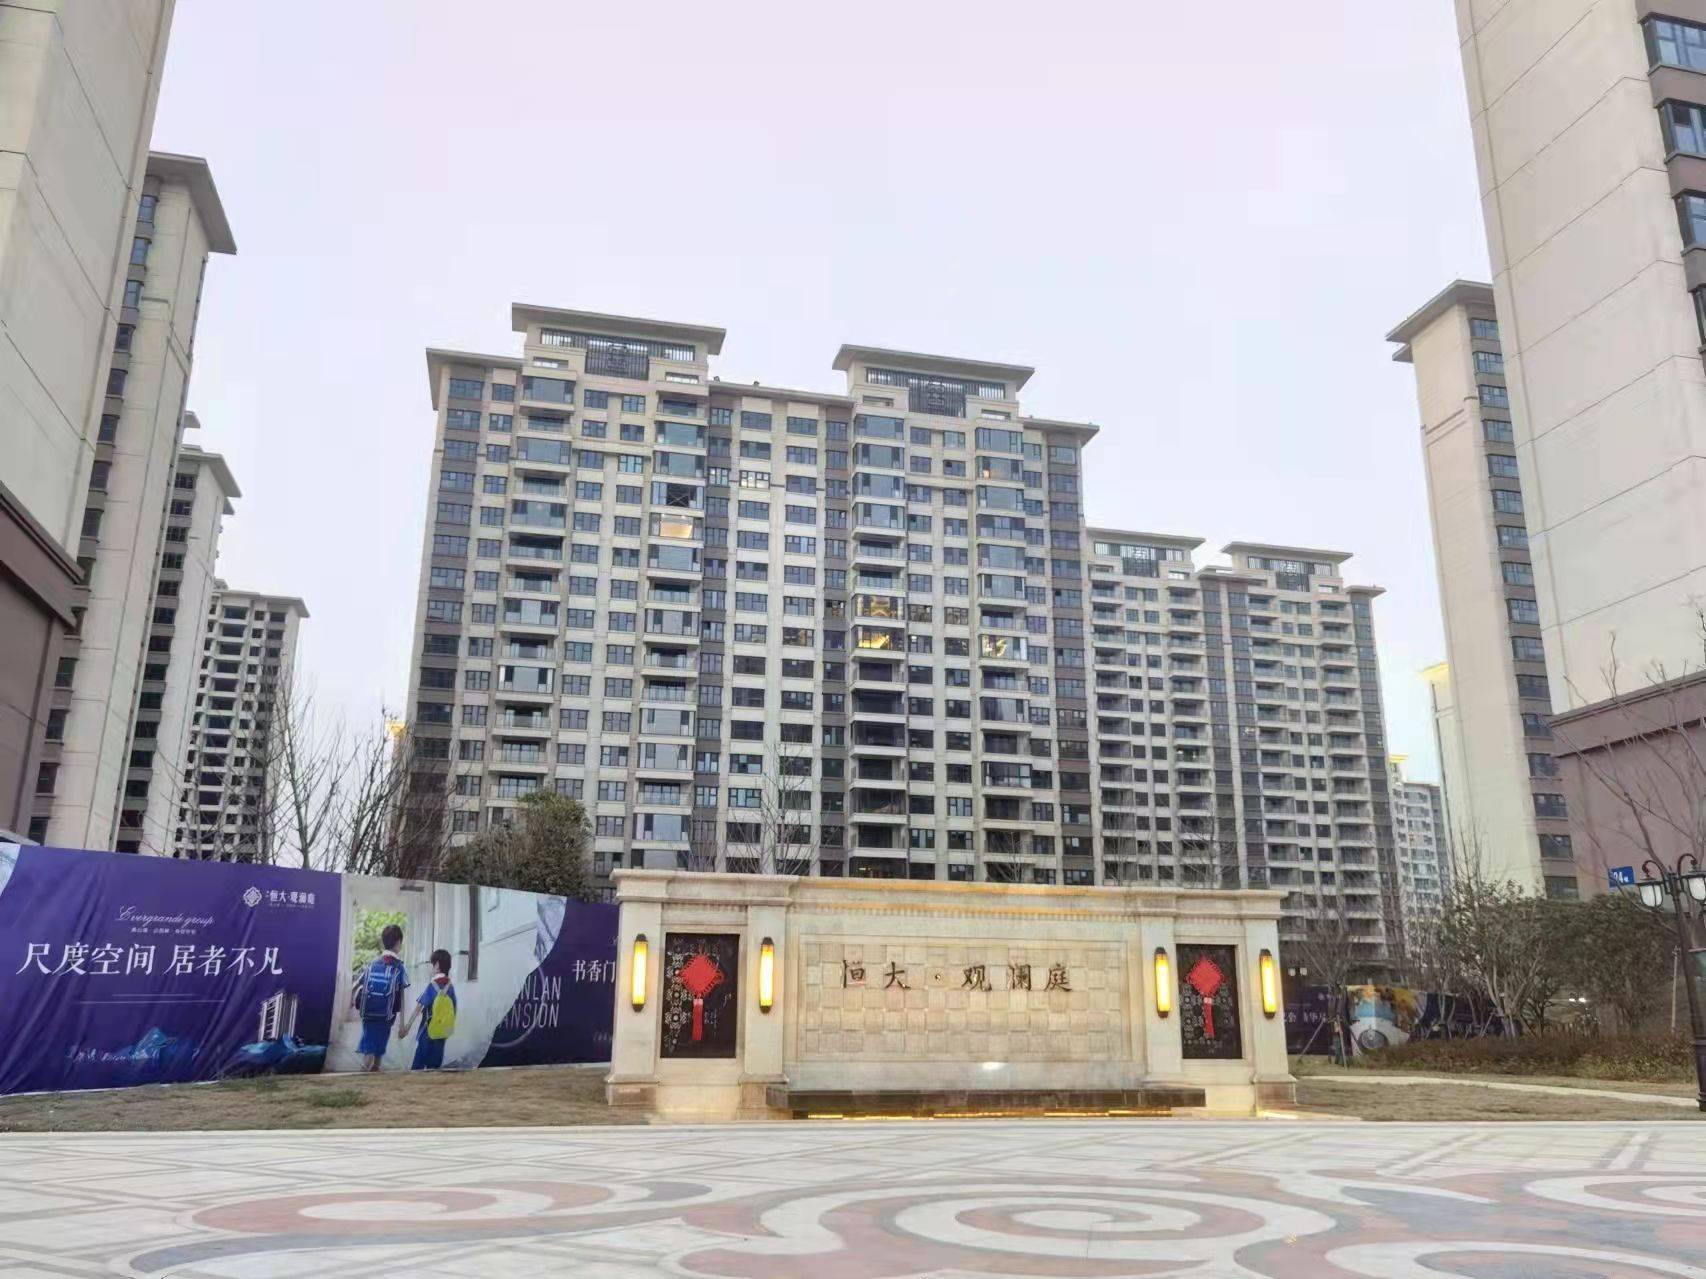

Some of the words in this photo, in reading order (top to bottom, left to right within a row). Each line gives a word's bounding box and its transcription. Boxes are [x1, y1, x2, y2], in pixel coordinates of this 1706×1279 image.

[15, 942, 156, 976] 尺度空间
[162, 944, 284, 976] 居者不凡
